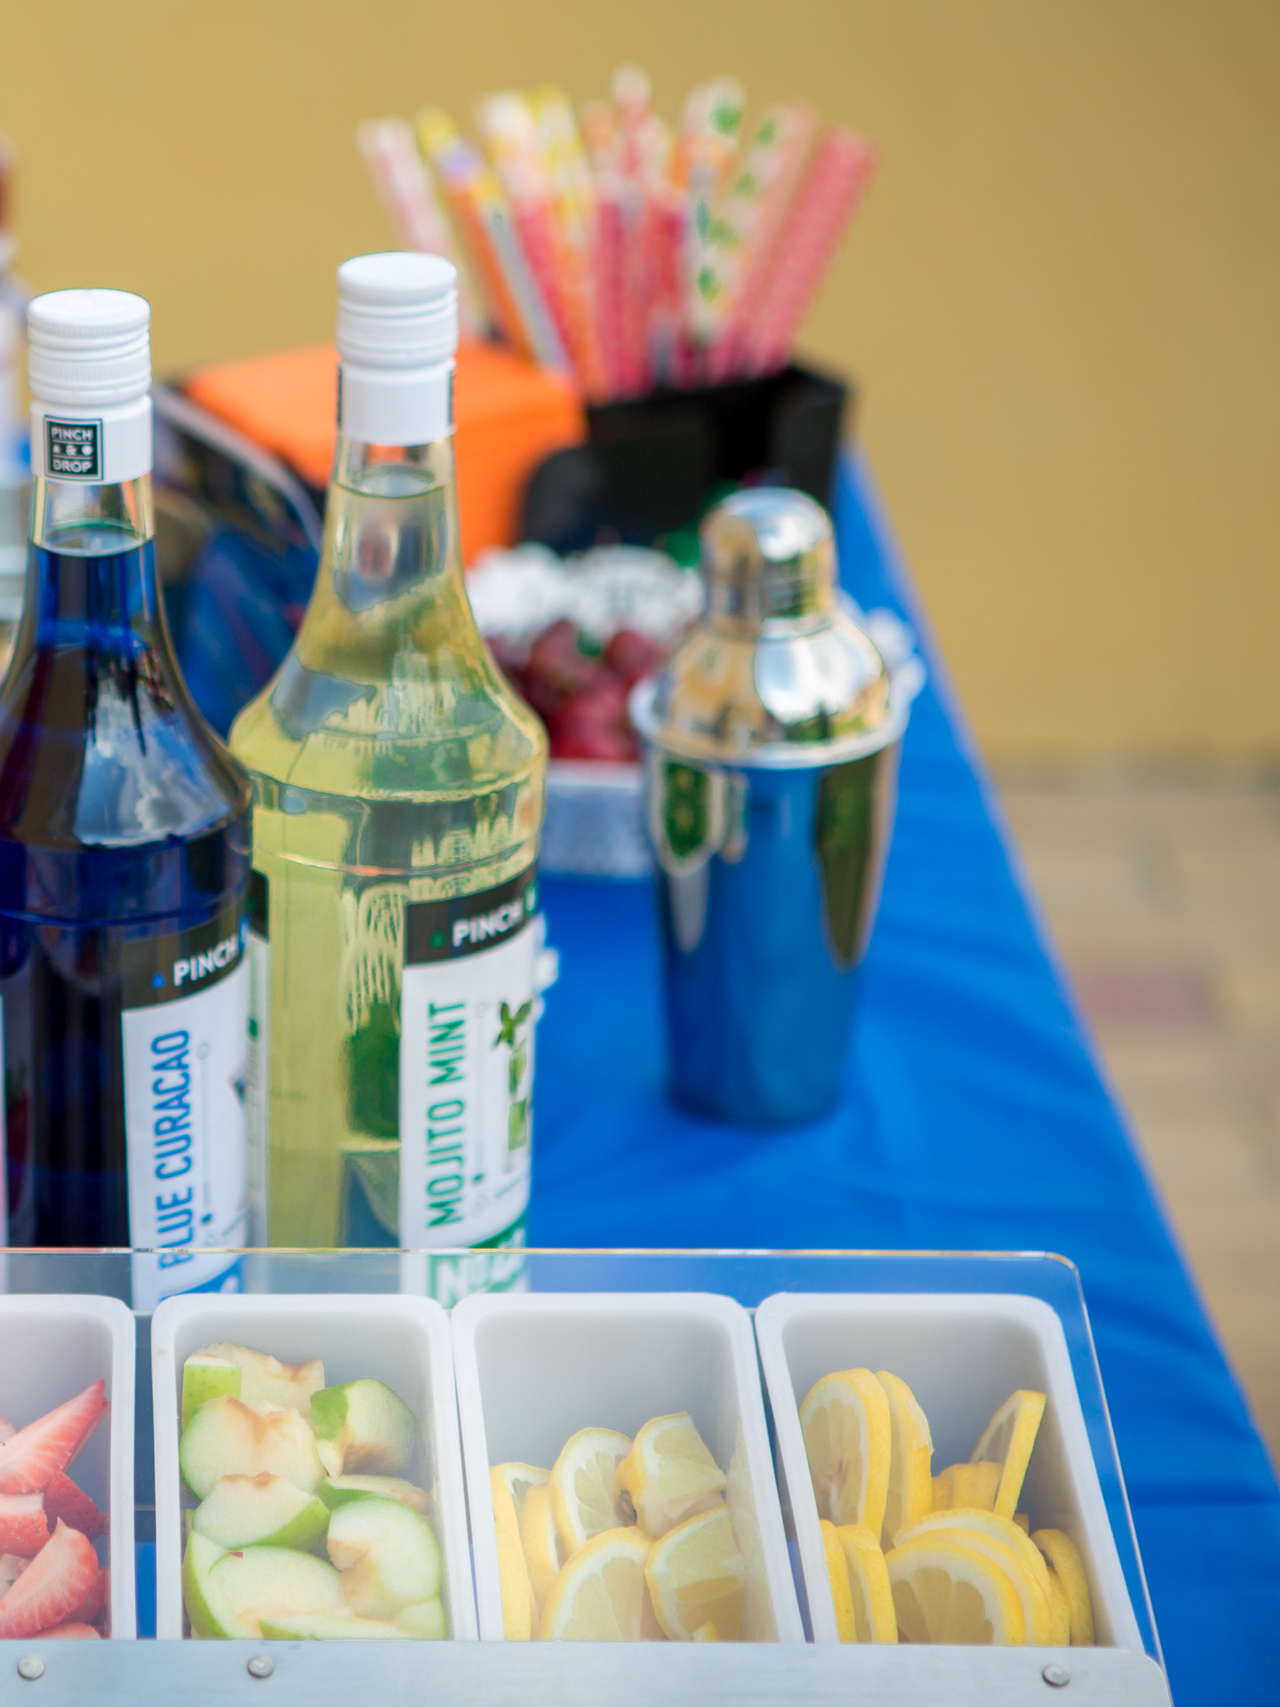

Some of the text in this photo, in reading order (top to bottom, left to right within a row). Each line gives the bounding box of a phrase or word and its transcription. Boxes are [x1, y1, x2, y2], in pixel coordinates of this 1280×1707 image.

[51, 427, 93, 441] PINCH
[66, 444, 77, 456] &
[53, 458, 92, 473] DROP
[453, 898, 523, 947] PINCH
[173, 933, 238, 987] PINCH
[426, 1002, 466, 1228] MOJITO MINT
[150, 1029, 194, 1270] BLUE CURACAO
